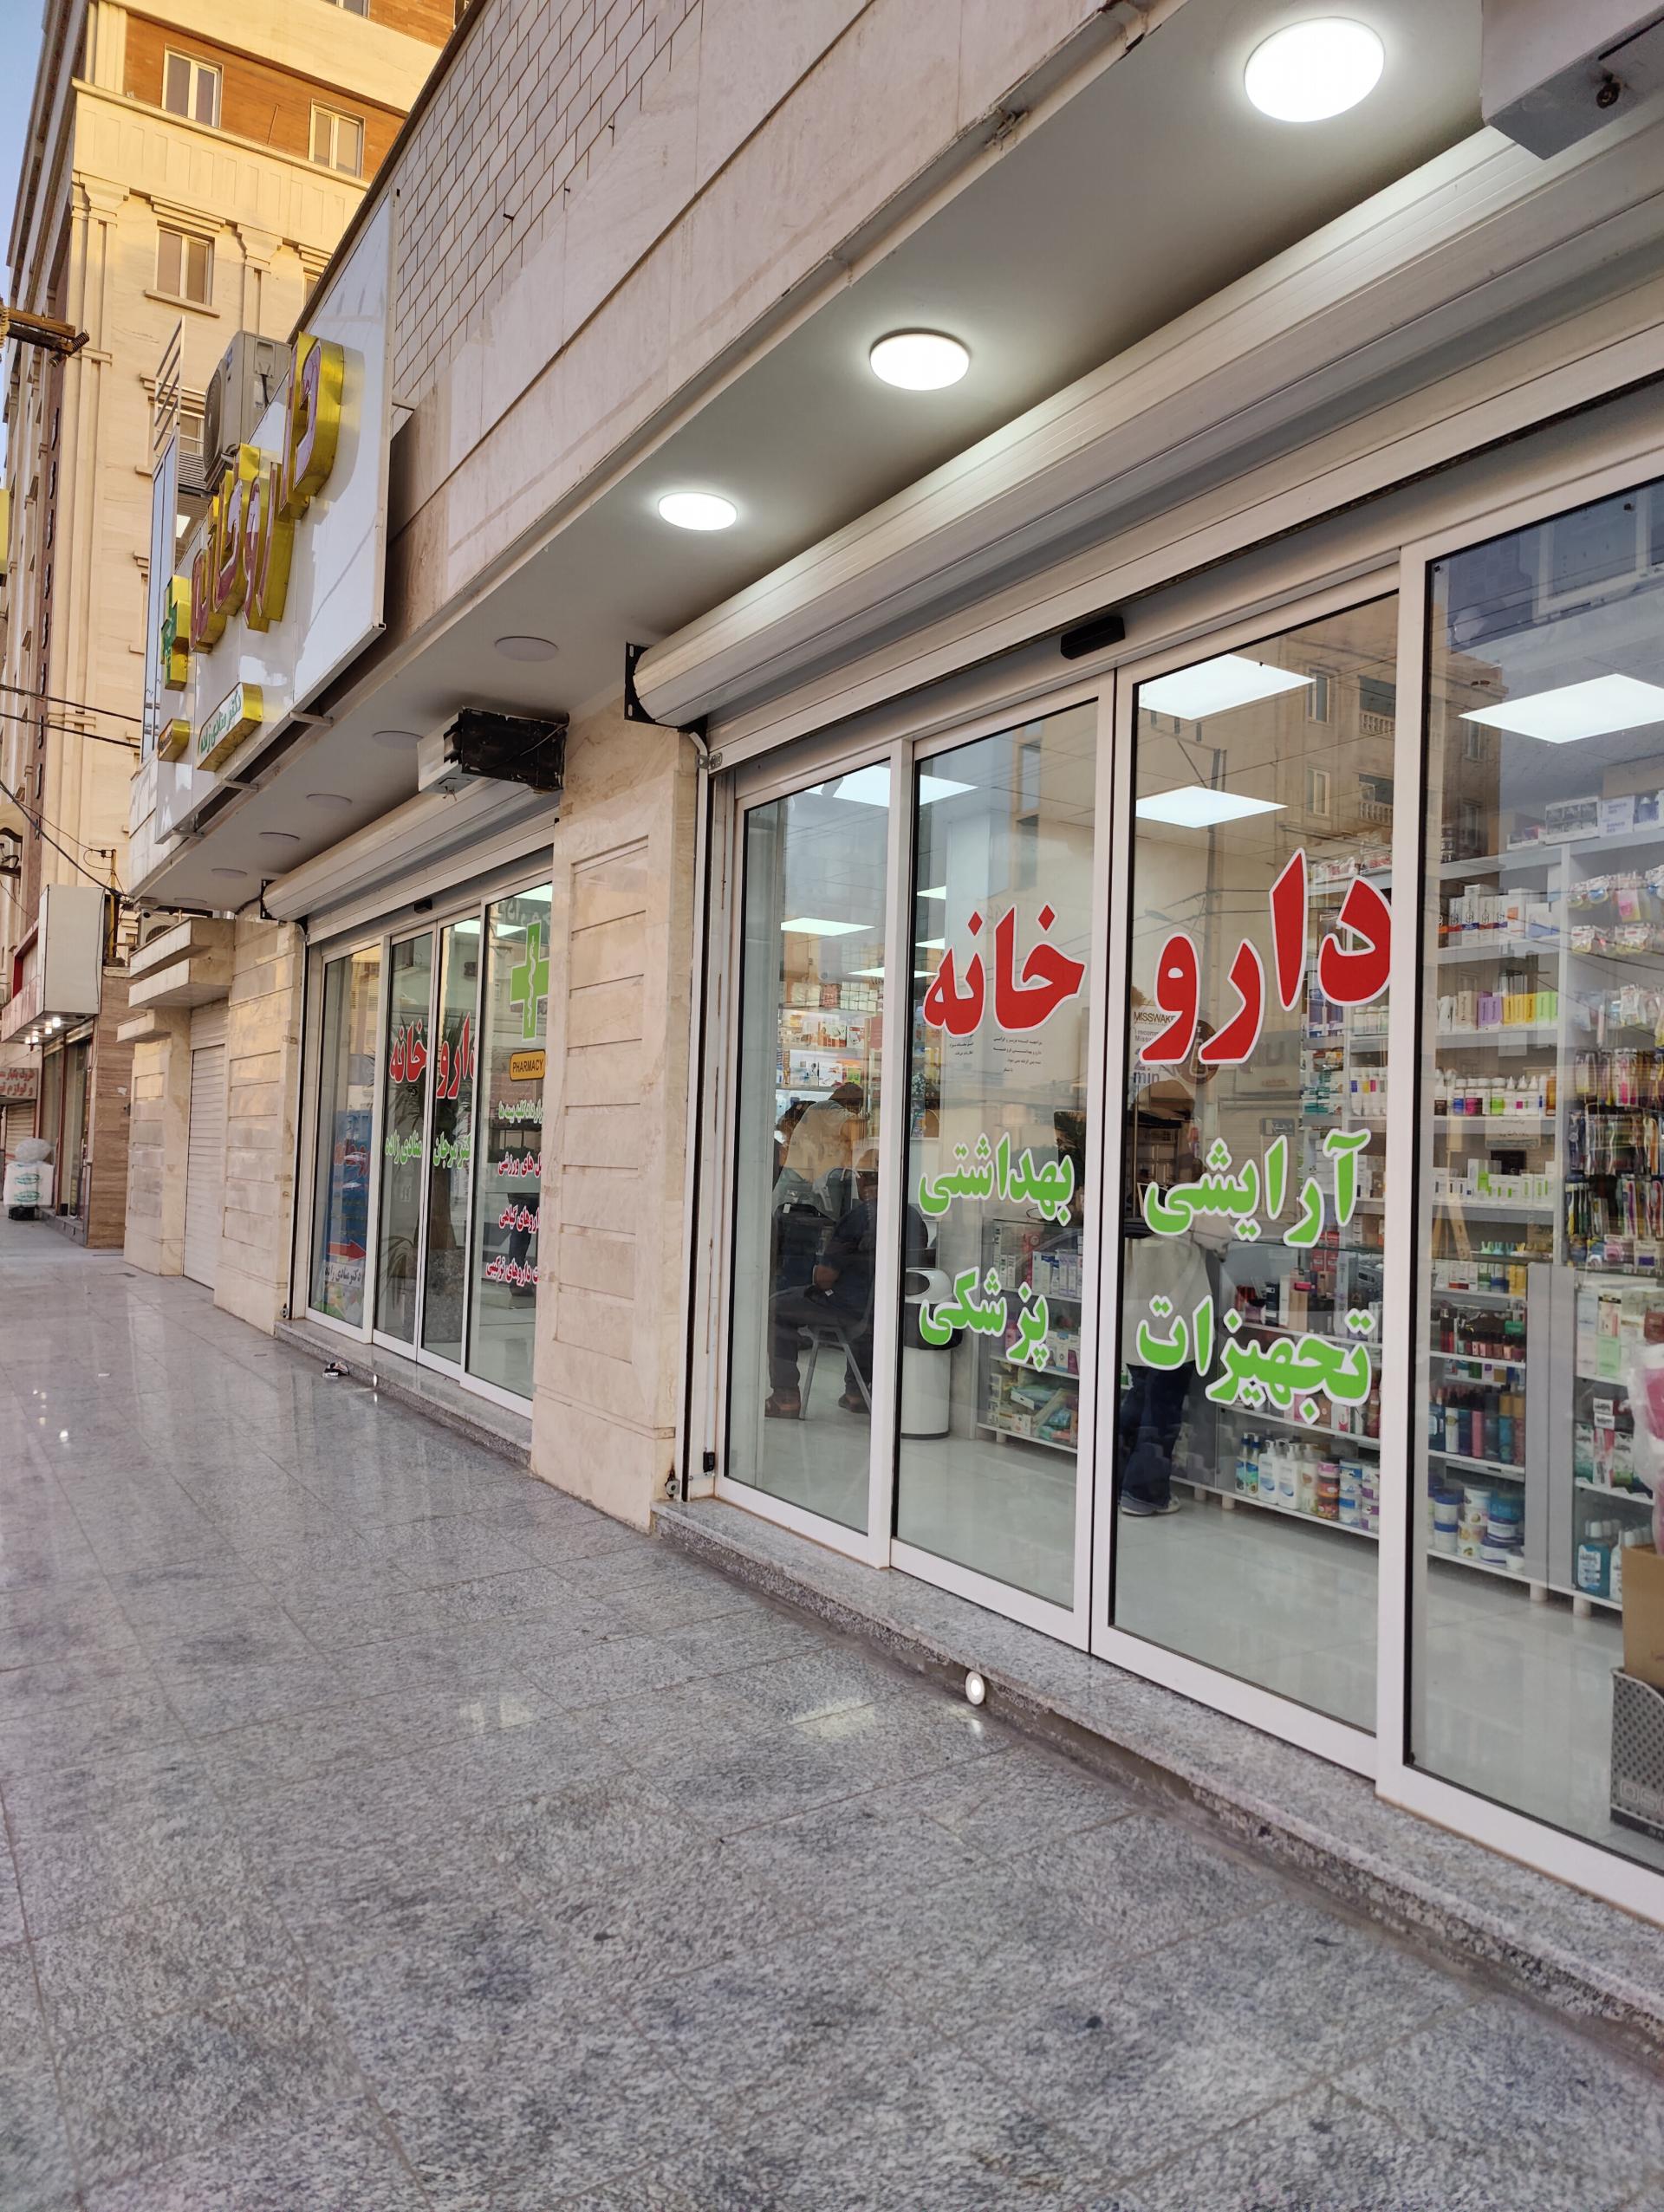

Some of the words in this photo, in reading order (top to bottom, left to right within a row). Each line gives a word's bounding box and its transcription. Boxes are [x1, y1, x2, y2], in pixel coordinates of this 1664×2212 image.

[512, 1059, 543, 1073] PHARMACY
[919, 1132, 1075, 1226] بهداشتی
[1142, 1128, 1371, 1247] آرایشی
[919, 1266, 1050, 1372] پزشکی
[1136, 1294, 1376, 1423] تجهیزات
